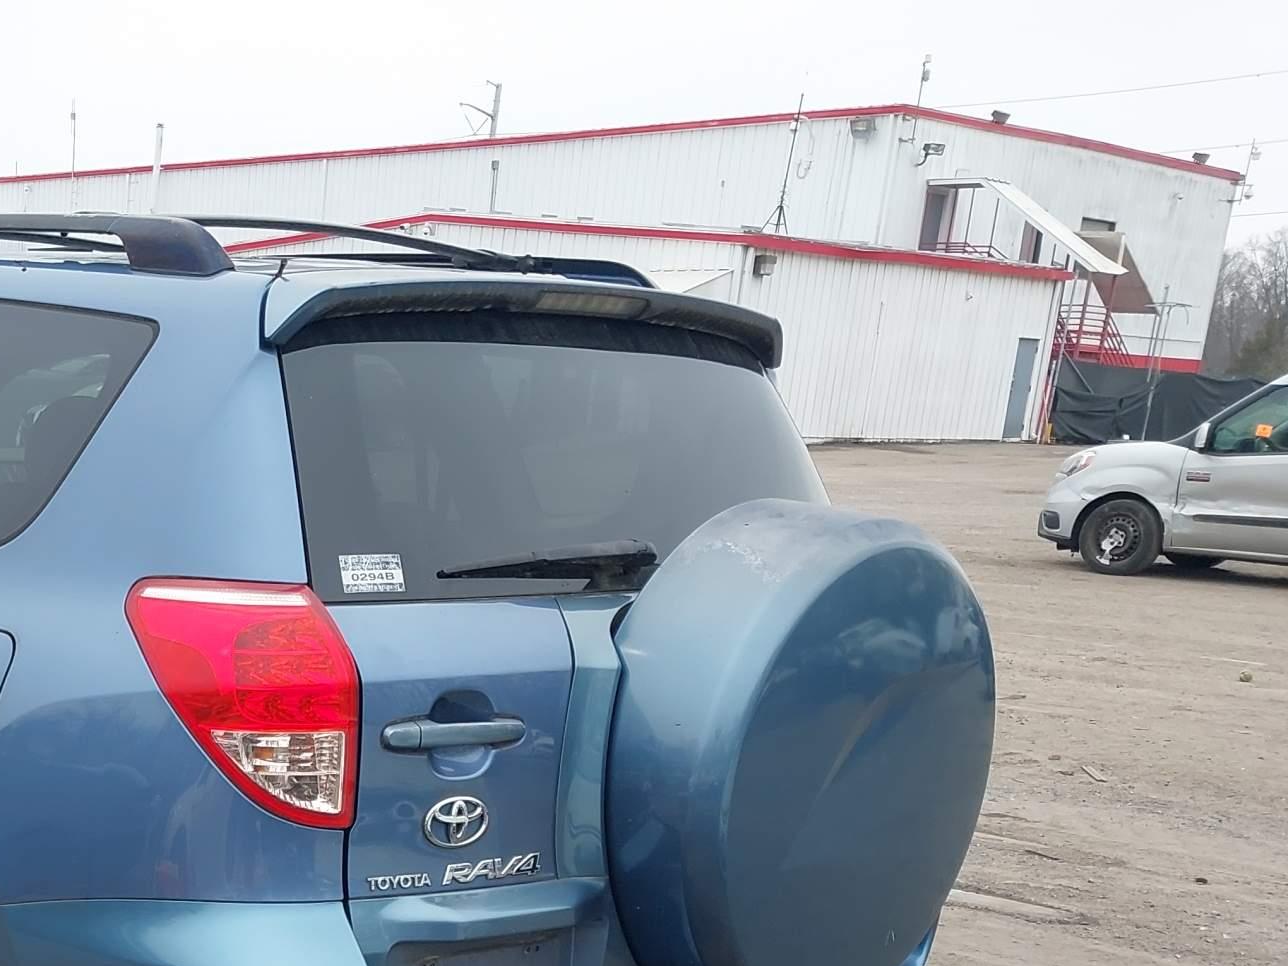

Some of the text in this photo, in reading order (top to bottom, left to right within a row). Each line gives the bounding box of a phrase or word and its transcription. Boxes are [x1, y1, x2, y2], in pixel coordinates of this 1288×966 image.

[351, 571, 395, 582] 0294B
[367, 851, 541, 892] TOYOTA RAV4
